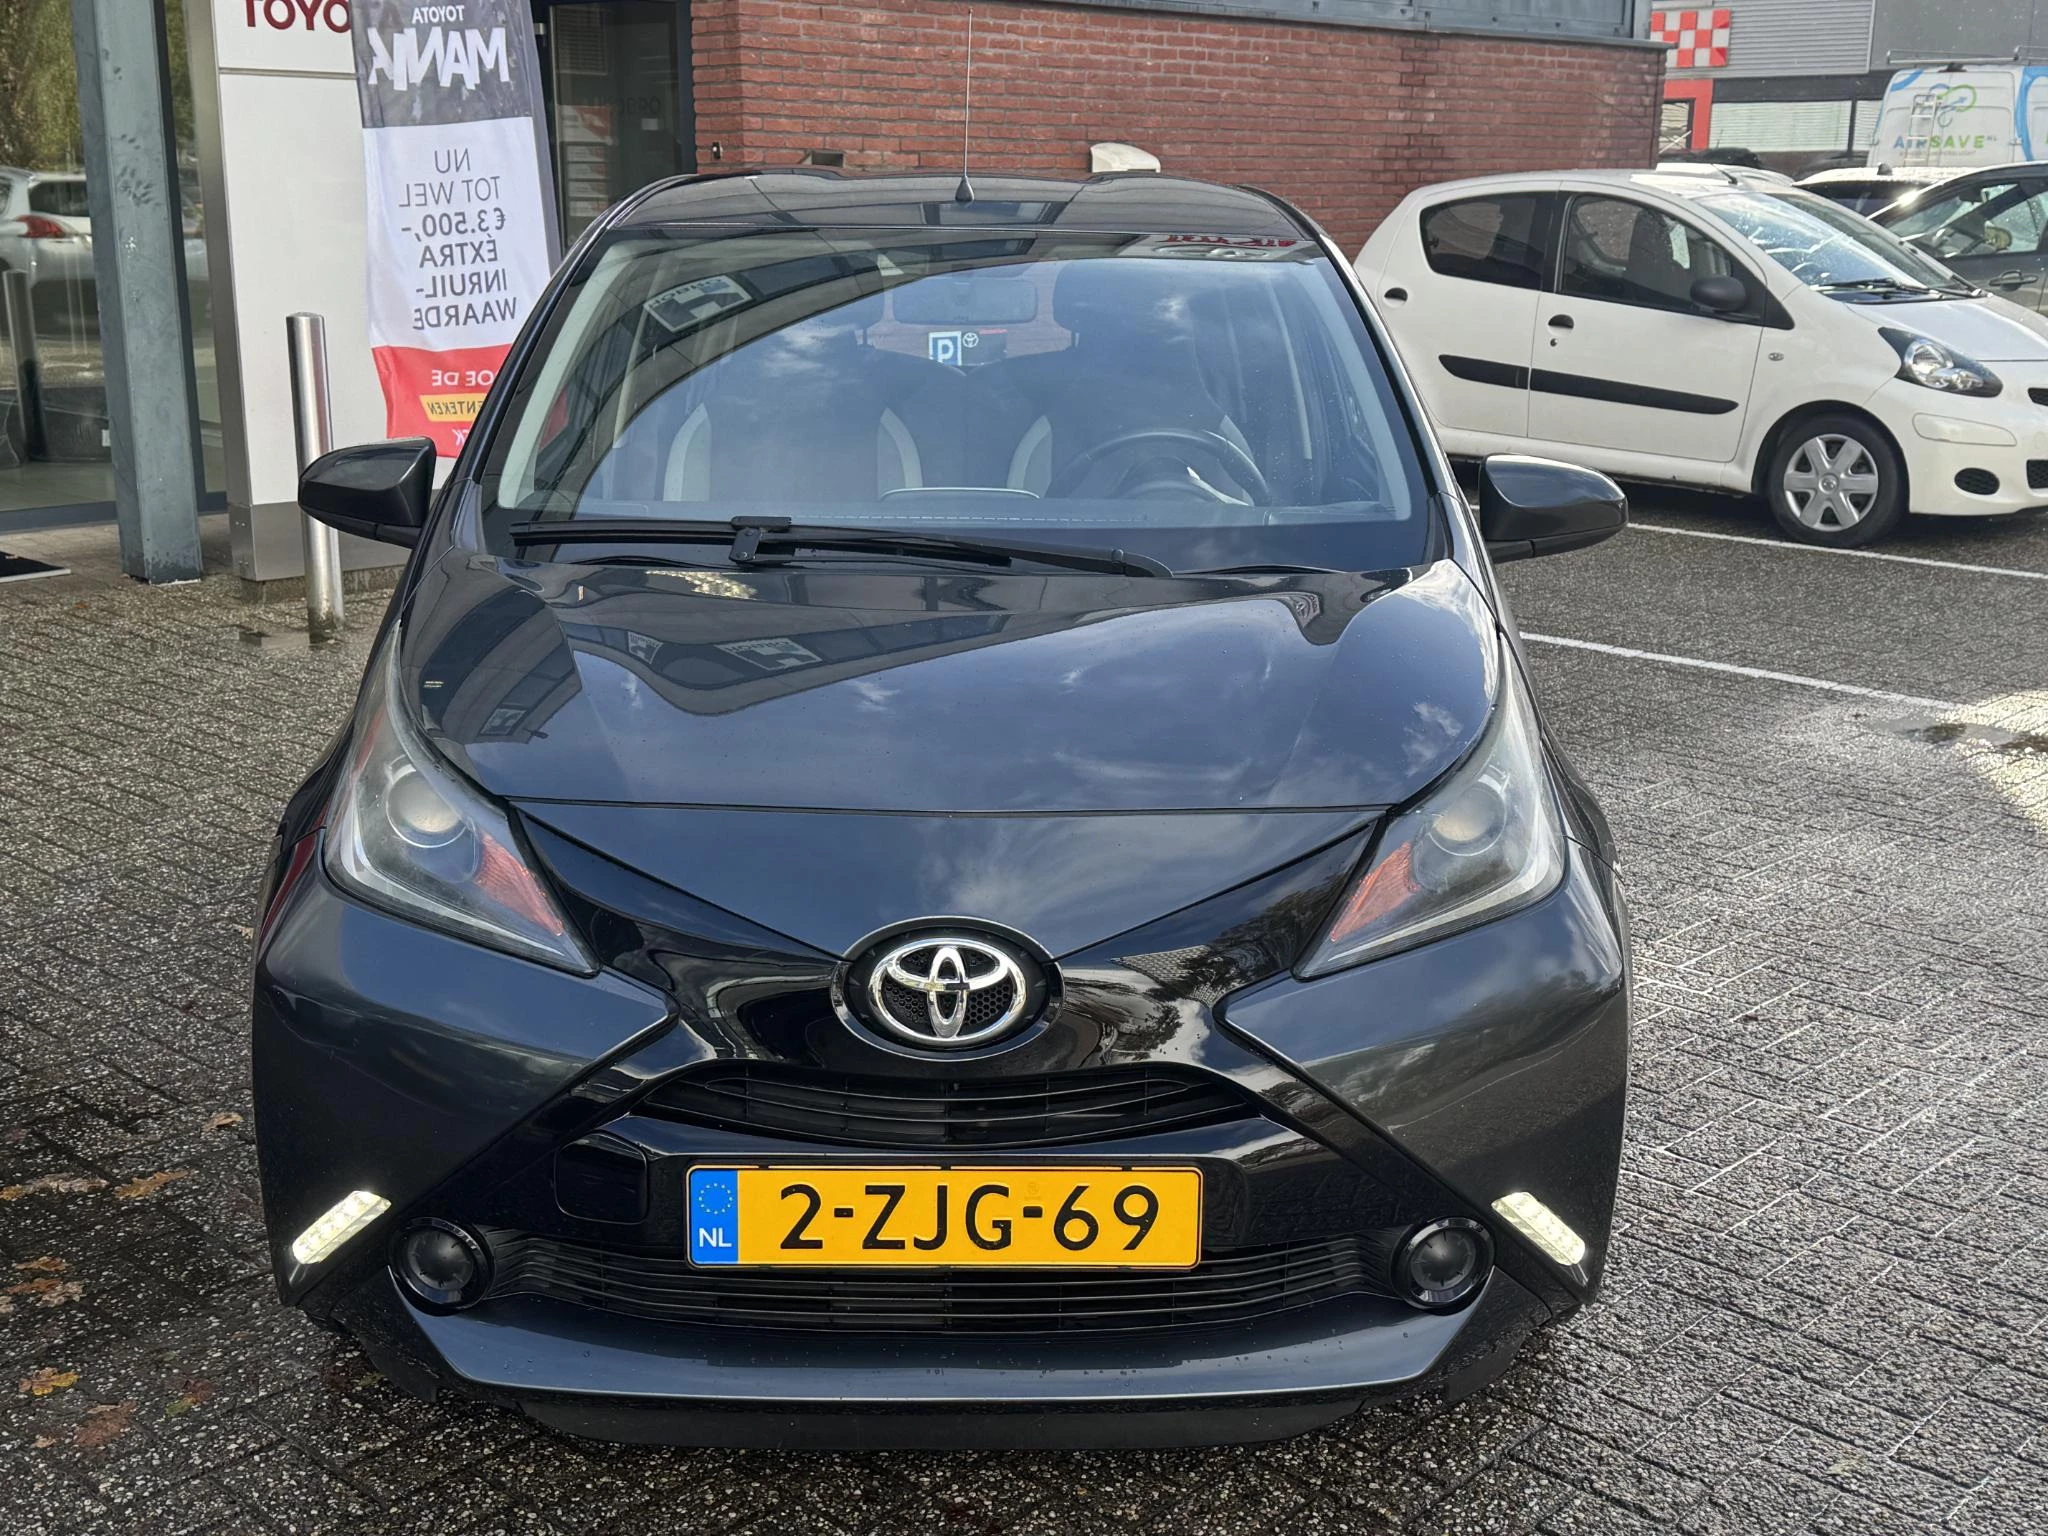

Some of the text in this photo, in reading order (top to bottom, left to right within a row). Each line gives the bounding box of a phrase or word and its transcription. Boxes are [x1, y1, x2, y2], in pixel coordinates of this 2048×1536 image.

[937, 339, 954, 363] P
[779, 1184, 1160, 1251] 2-ZJG-69
[698, 1227, 732, 1248] NL
